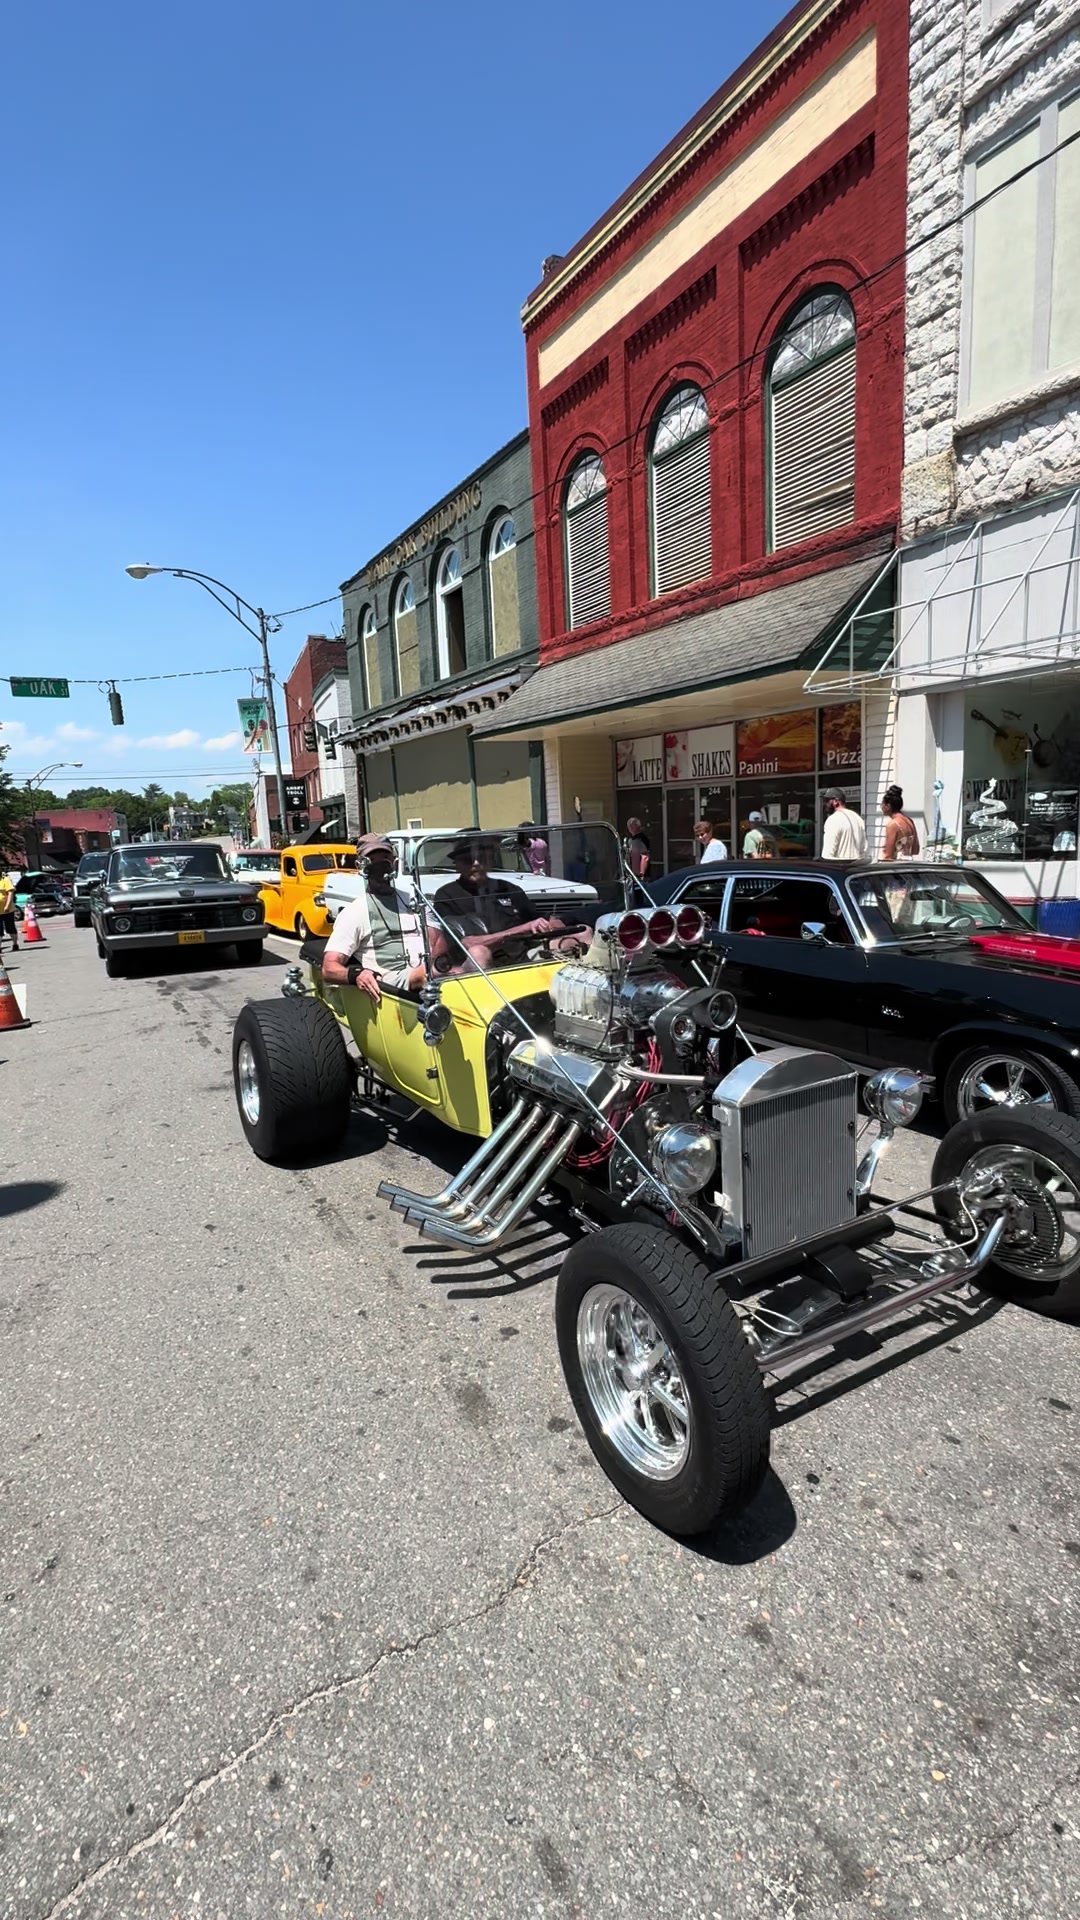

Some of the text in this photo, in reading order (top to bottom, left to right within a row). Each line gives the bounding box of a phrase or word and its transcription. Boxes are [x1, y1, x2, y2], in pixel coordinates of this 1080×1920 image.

[420, 480, 481, 546] BUILDING
[633, 758, 662, 782] LATTE
[692, 750, 731, 777] SHAKES
[739, 758, 778, 775] Panini
[708, 787, 720, 796] 244
